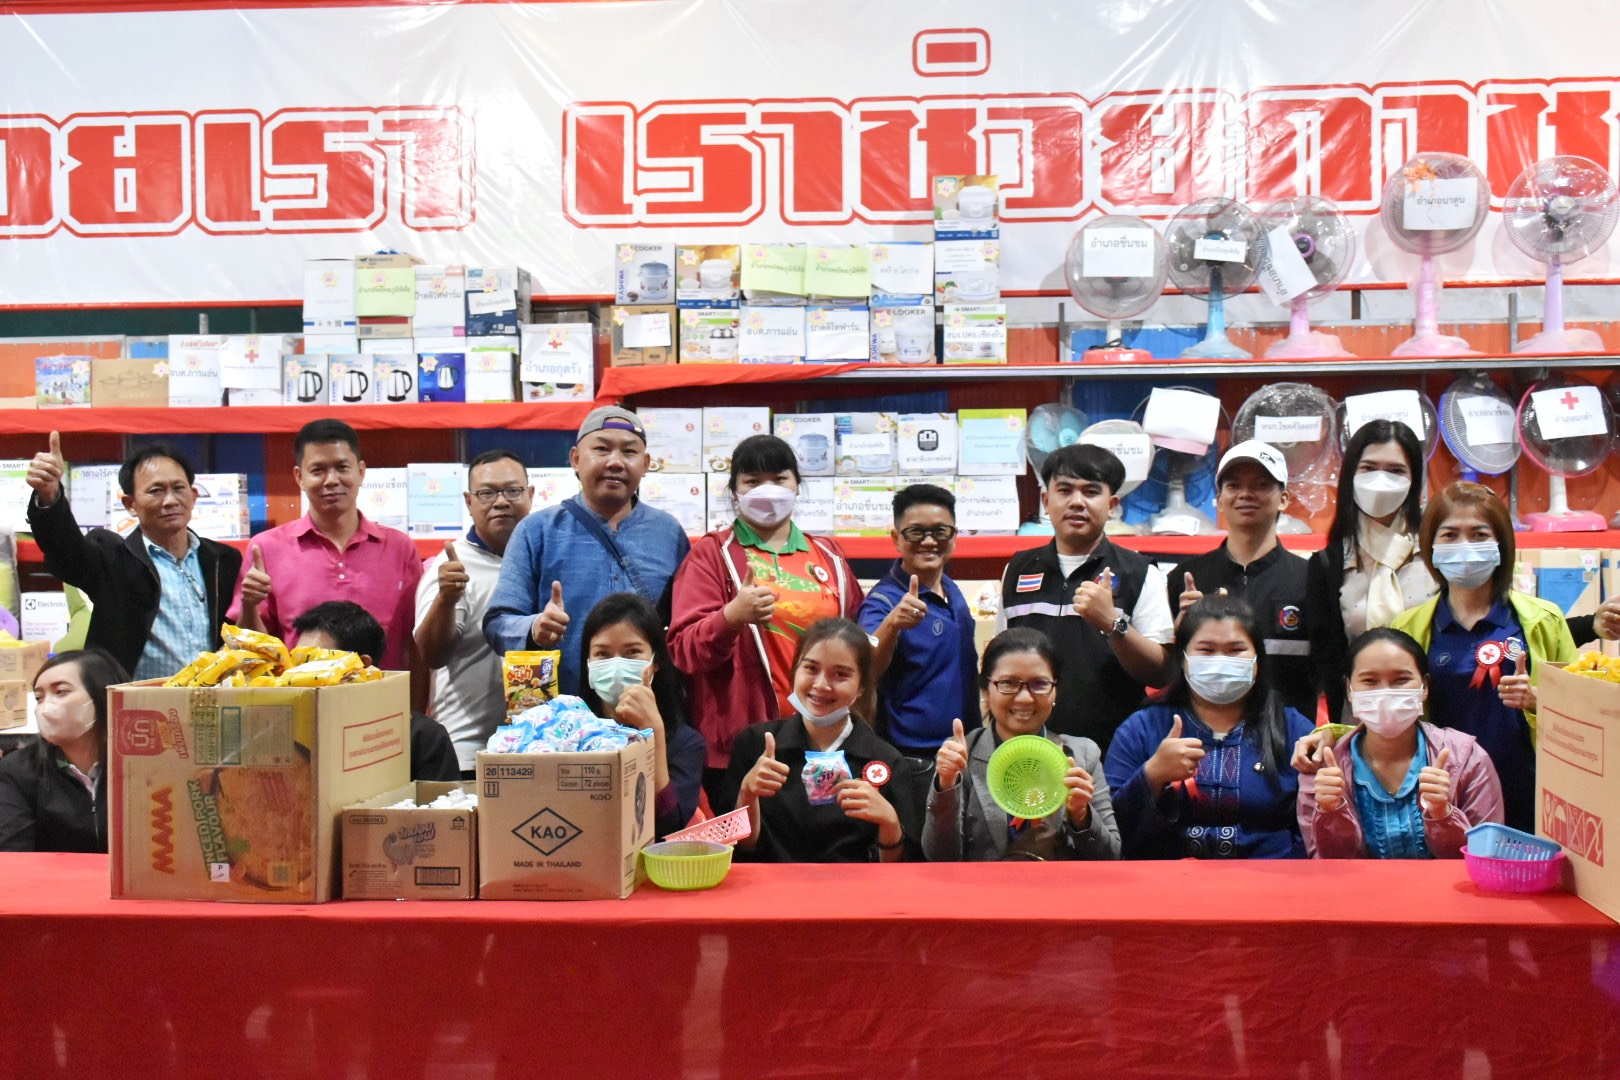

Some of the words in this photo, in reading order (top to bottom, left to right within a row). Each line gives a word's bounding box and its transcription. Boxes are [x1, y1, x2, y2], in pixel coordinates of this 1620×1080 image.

[1091, 234, 1147, 249] อำเภอชื่นชม
[525, 361, 581, 377] อำเภอกุดรัง
[836, 497, 891, 511] อำเภอชื่นชม
[38, 600, 66, 608] Electrolu
[486, 767, 497, 776] 26
[500, 767, 533, 776] 113429
[584, 780, 592, 788] 72
[187, 779, 206, 819] PORK
[151, 786, 175, 875] MAMA
[205, 794, 227, 863] FLAVOUR
[531, 826, 567, 840] KAO
